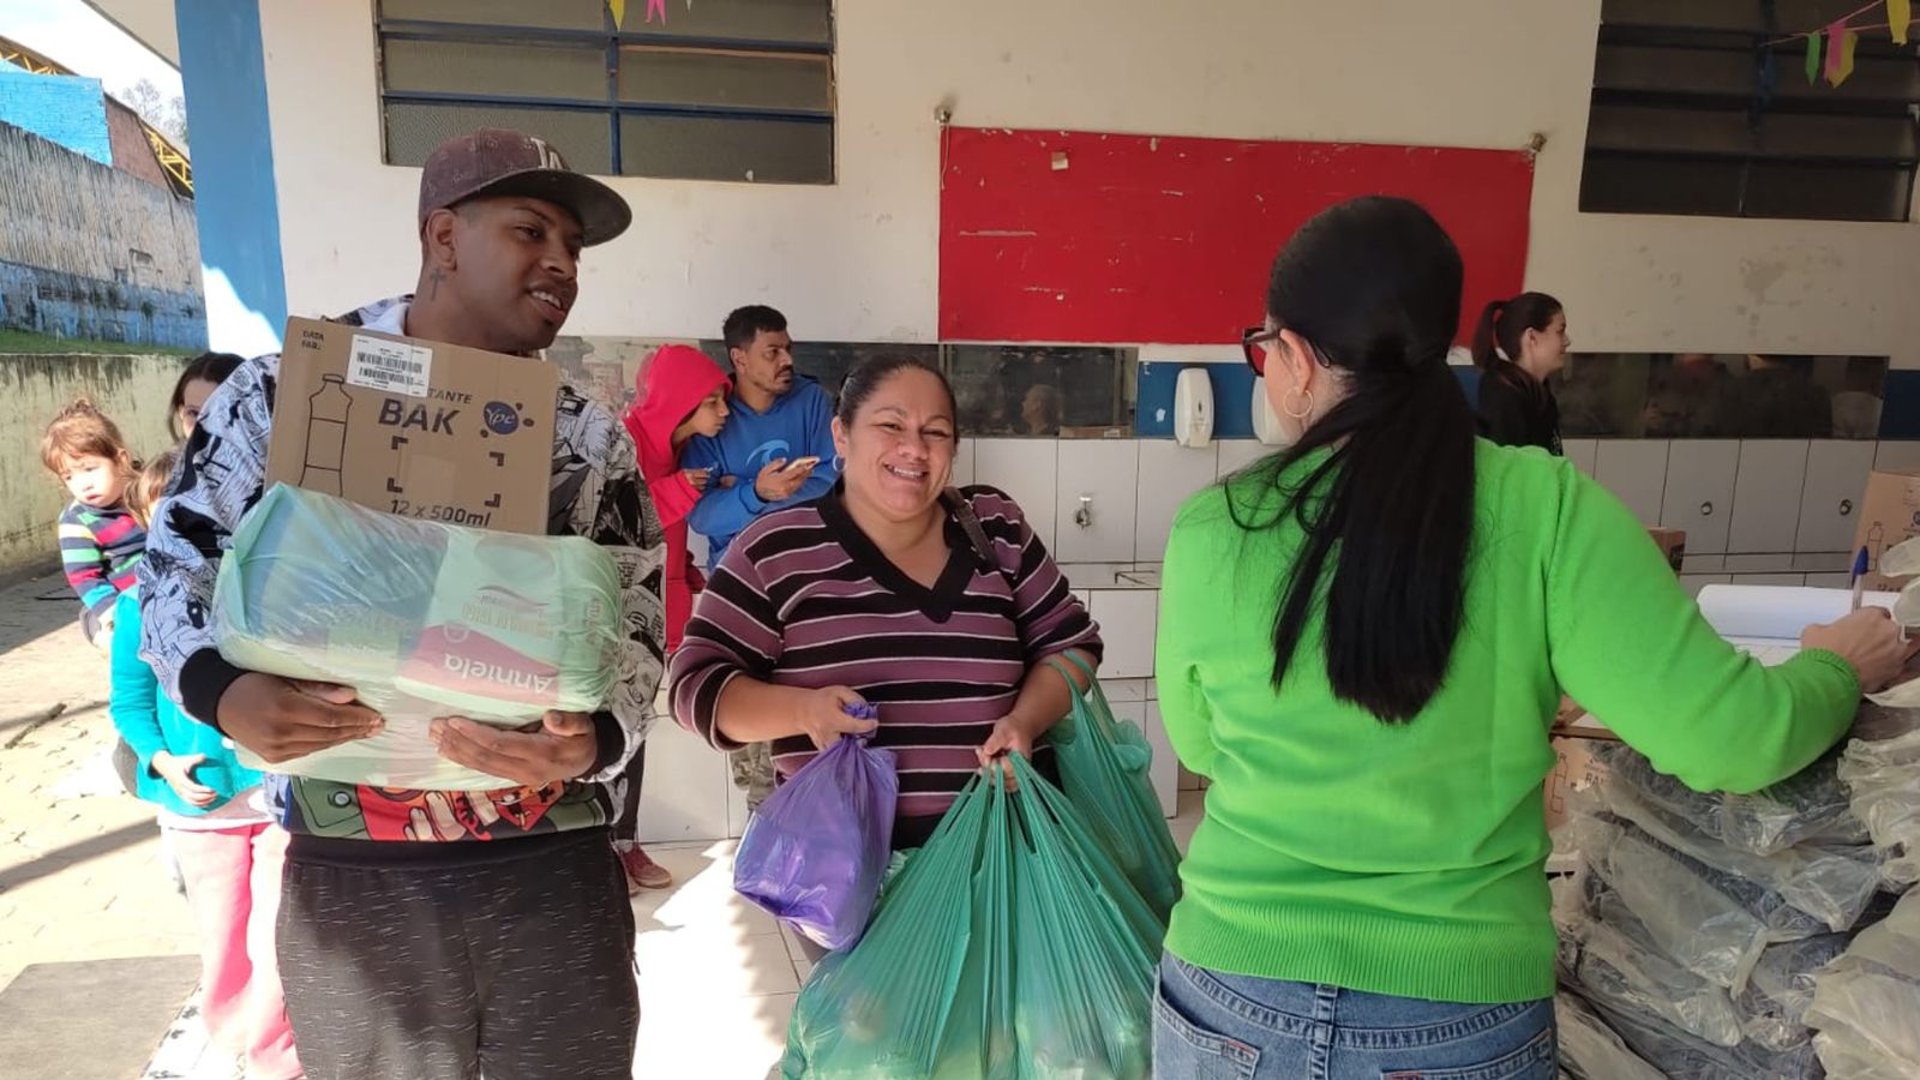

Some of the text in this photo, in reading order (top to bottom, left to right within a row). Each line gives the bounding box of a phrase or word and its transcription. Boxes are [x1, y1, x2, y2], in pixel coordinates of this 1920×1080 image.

[428, 388, 473, 404] TANTE
[378, 398, 460, 436] BAK
[391, 499, 411, 515] 12
[430, 504, 492, 528] 500ml
